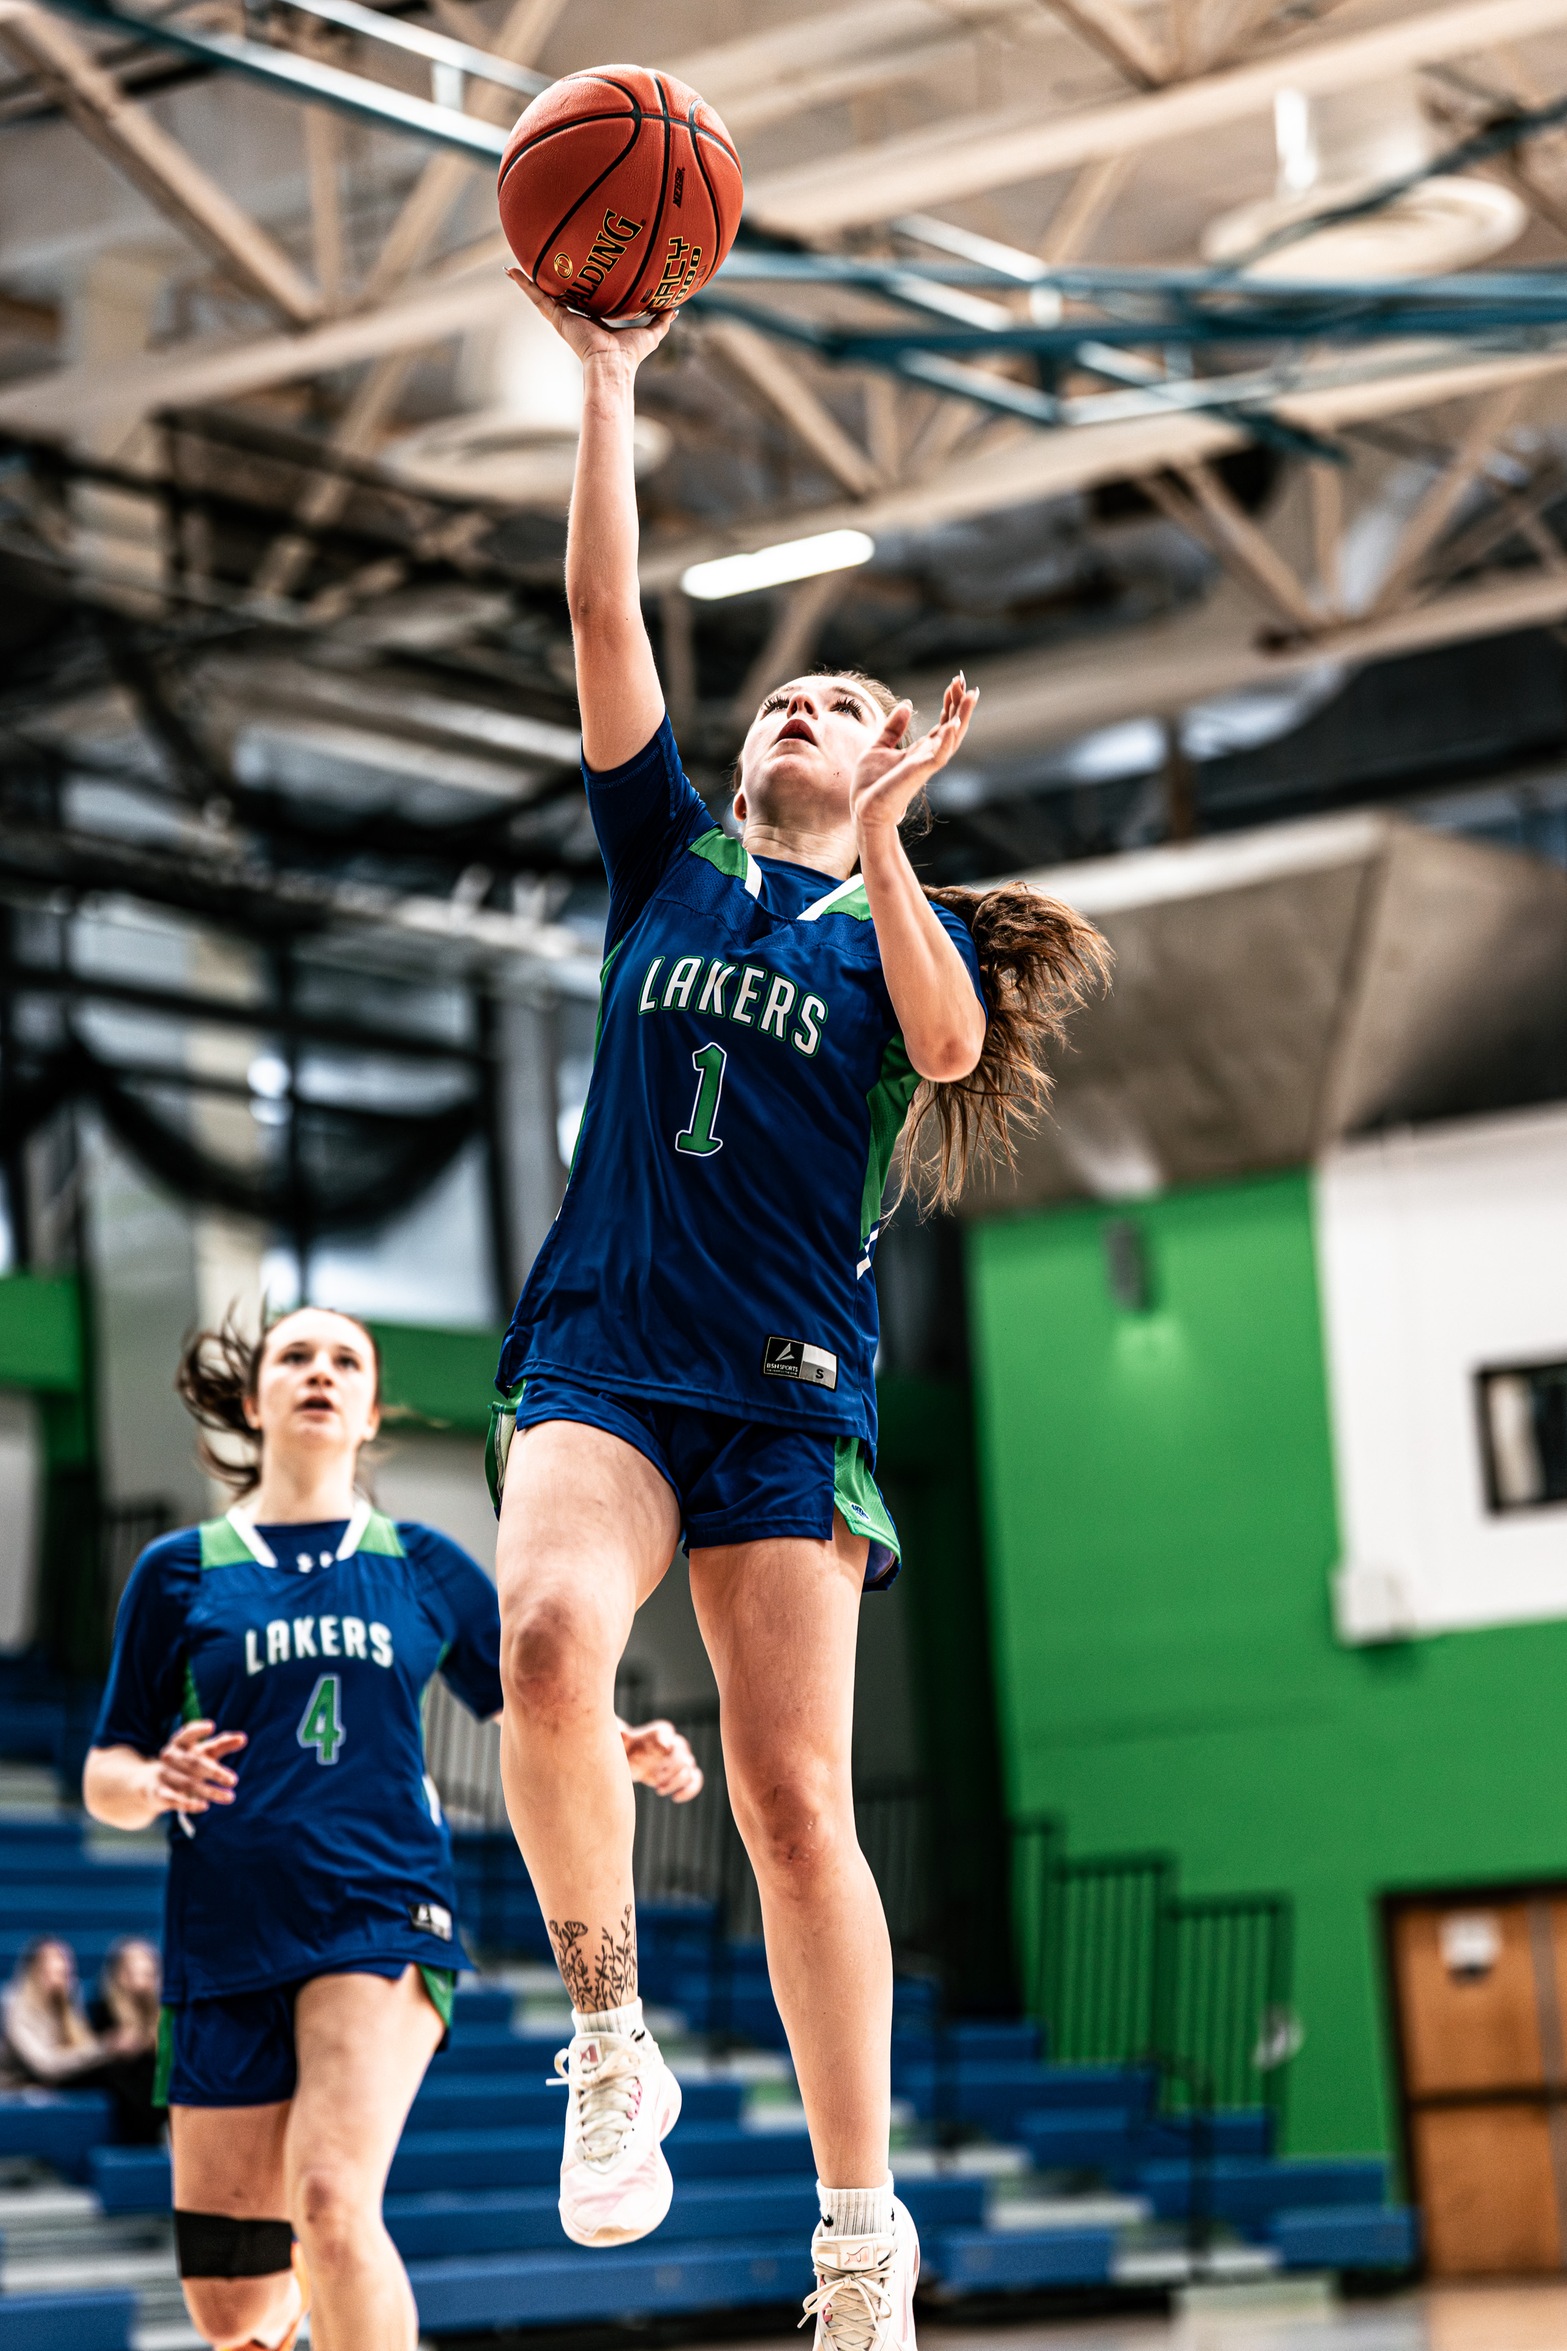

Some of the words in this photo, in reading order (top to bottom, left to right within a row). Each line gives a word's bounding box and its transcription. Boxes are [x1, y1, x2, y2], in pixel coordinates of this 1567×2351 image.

[638, 955, 828, 1057] LAKERS
[675, 1042, 727, 1157] 1
[815, 1368, 824, 1380] S
[245, 1615, 394, 1676] LAKERS
[297, 1673, 346, 1766] 4
